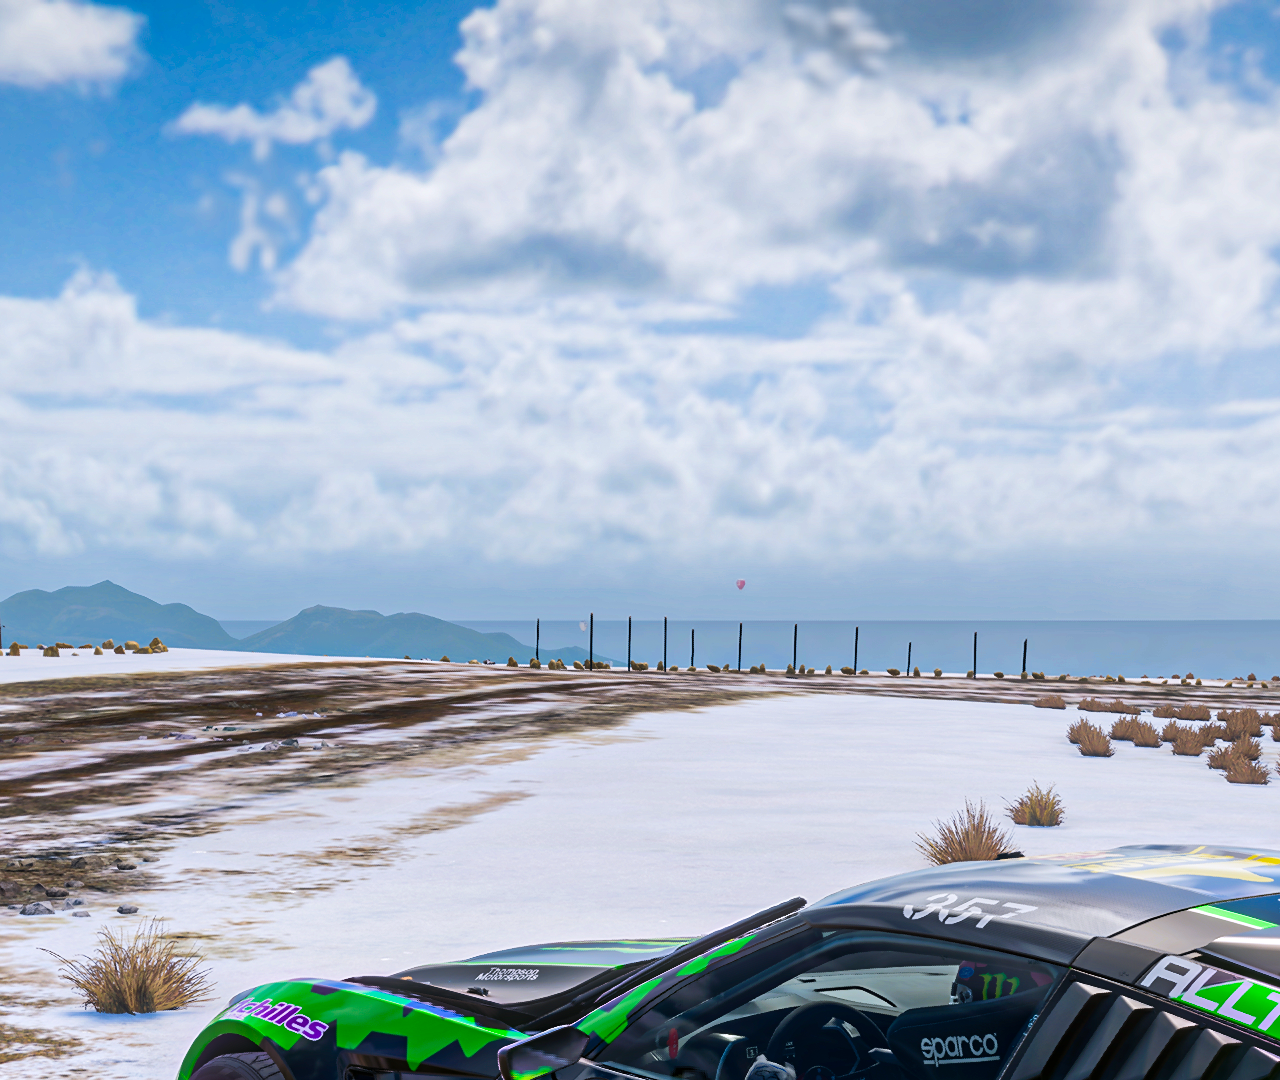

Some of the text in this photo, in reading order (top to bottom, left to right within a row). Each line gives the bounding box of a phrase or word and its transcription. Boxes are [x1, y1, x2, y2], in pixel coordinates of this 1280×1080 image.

[903, 893, 1038, 929] 357
[474, 972, 539, 982] Motorsports
[490, 966, 540, 977] Thompson
[920, 1033, 999, 1068] sparco
